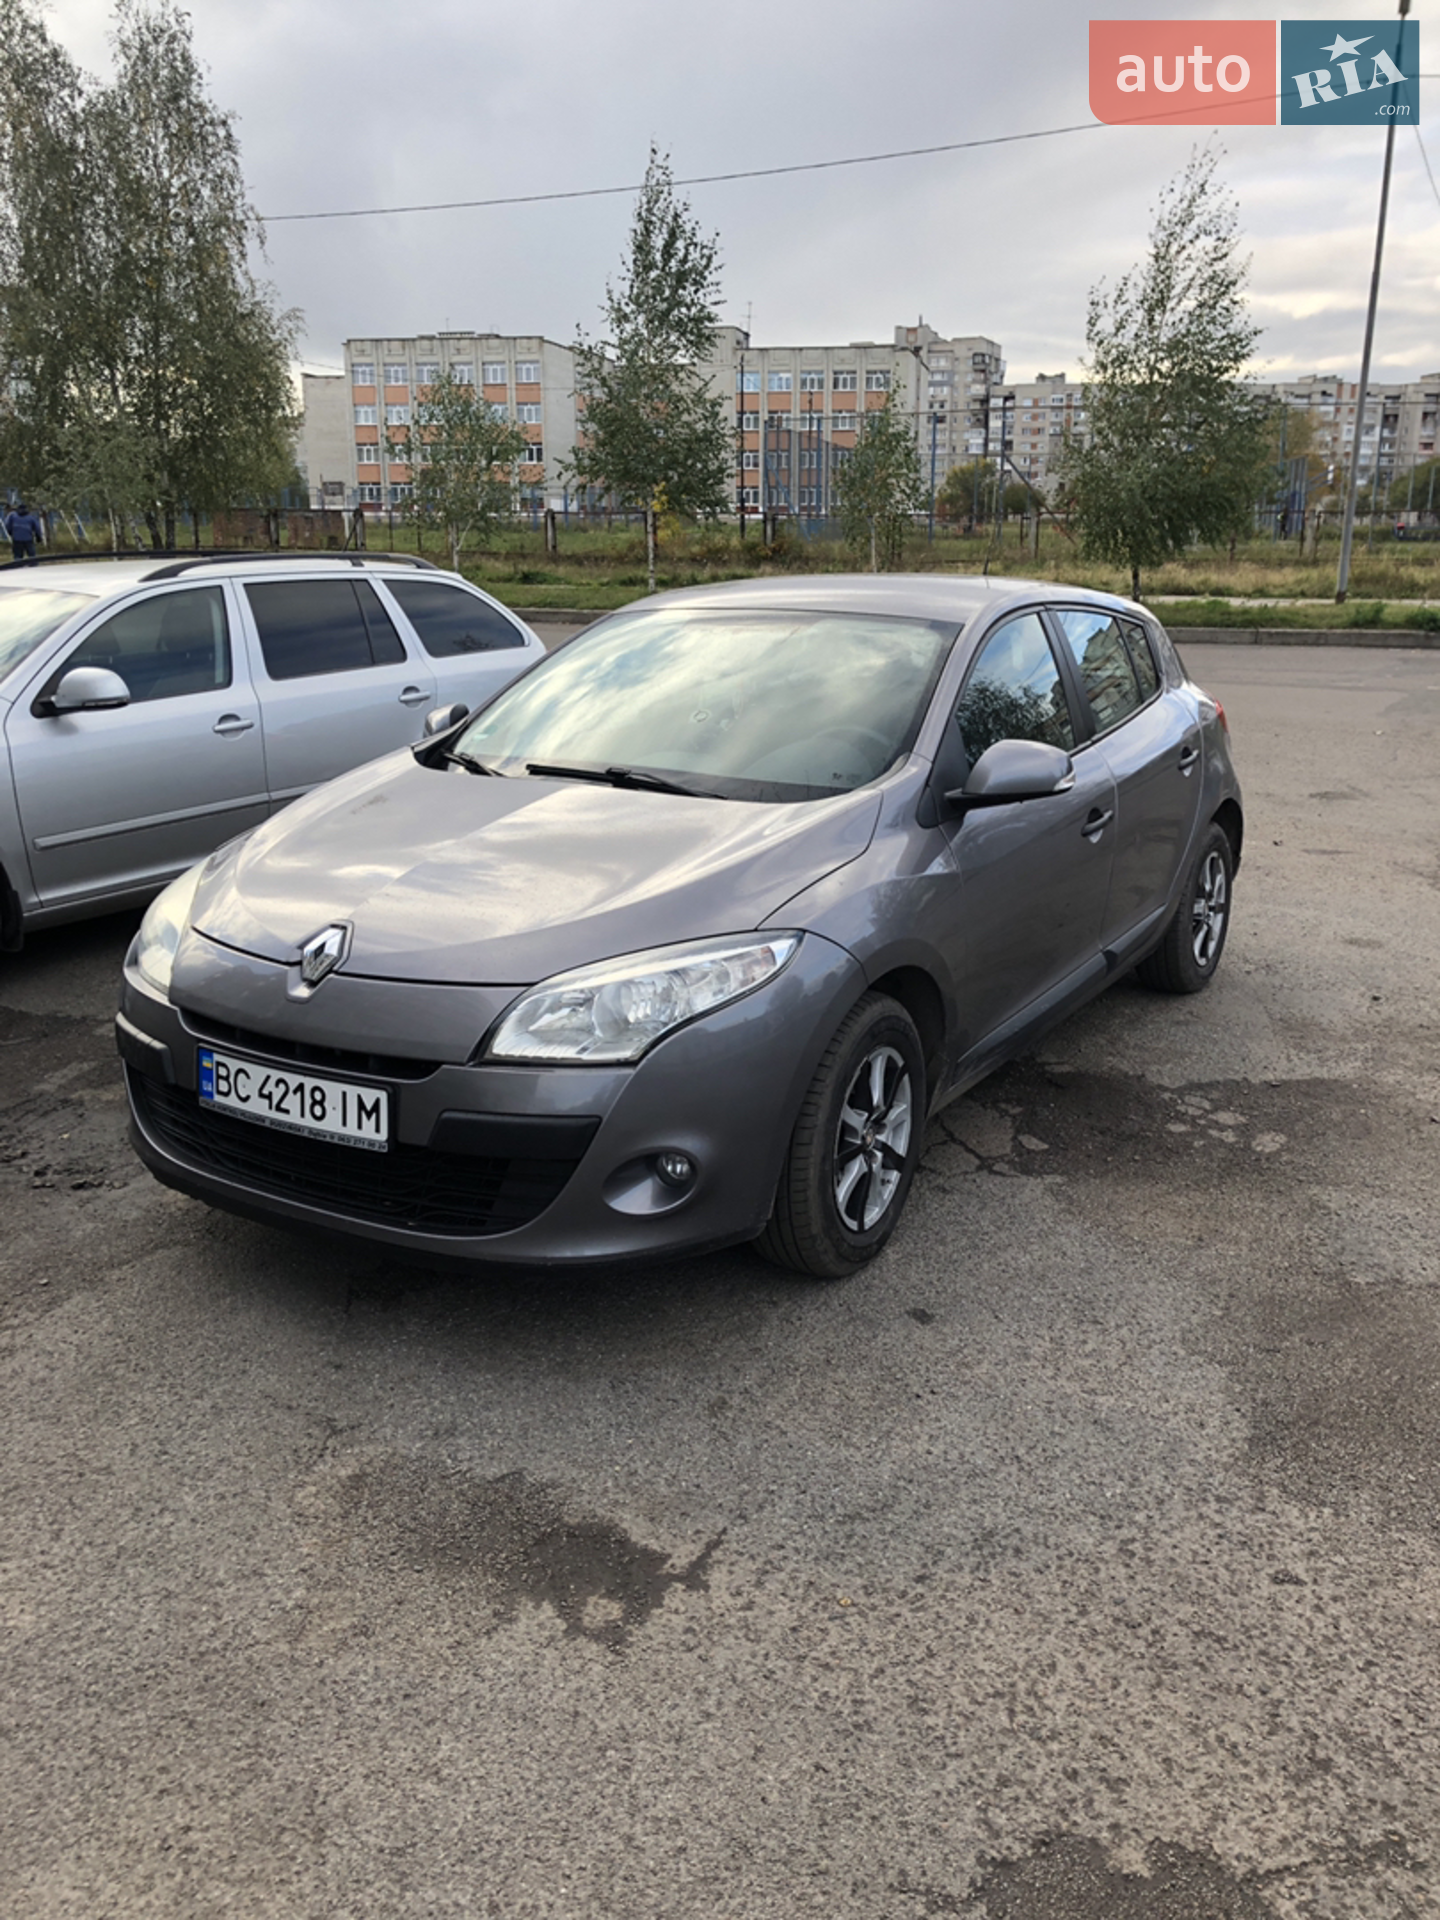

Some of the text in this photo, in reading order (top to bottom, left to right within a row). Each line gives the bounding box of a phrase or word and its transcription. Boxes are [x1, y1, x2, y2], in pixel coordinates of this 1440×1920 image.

[215, 1061, 251, 1103] BC
[258, 1074, 326, 1122] 4218
[341, 1090, 381, 1134] IM
